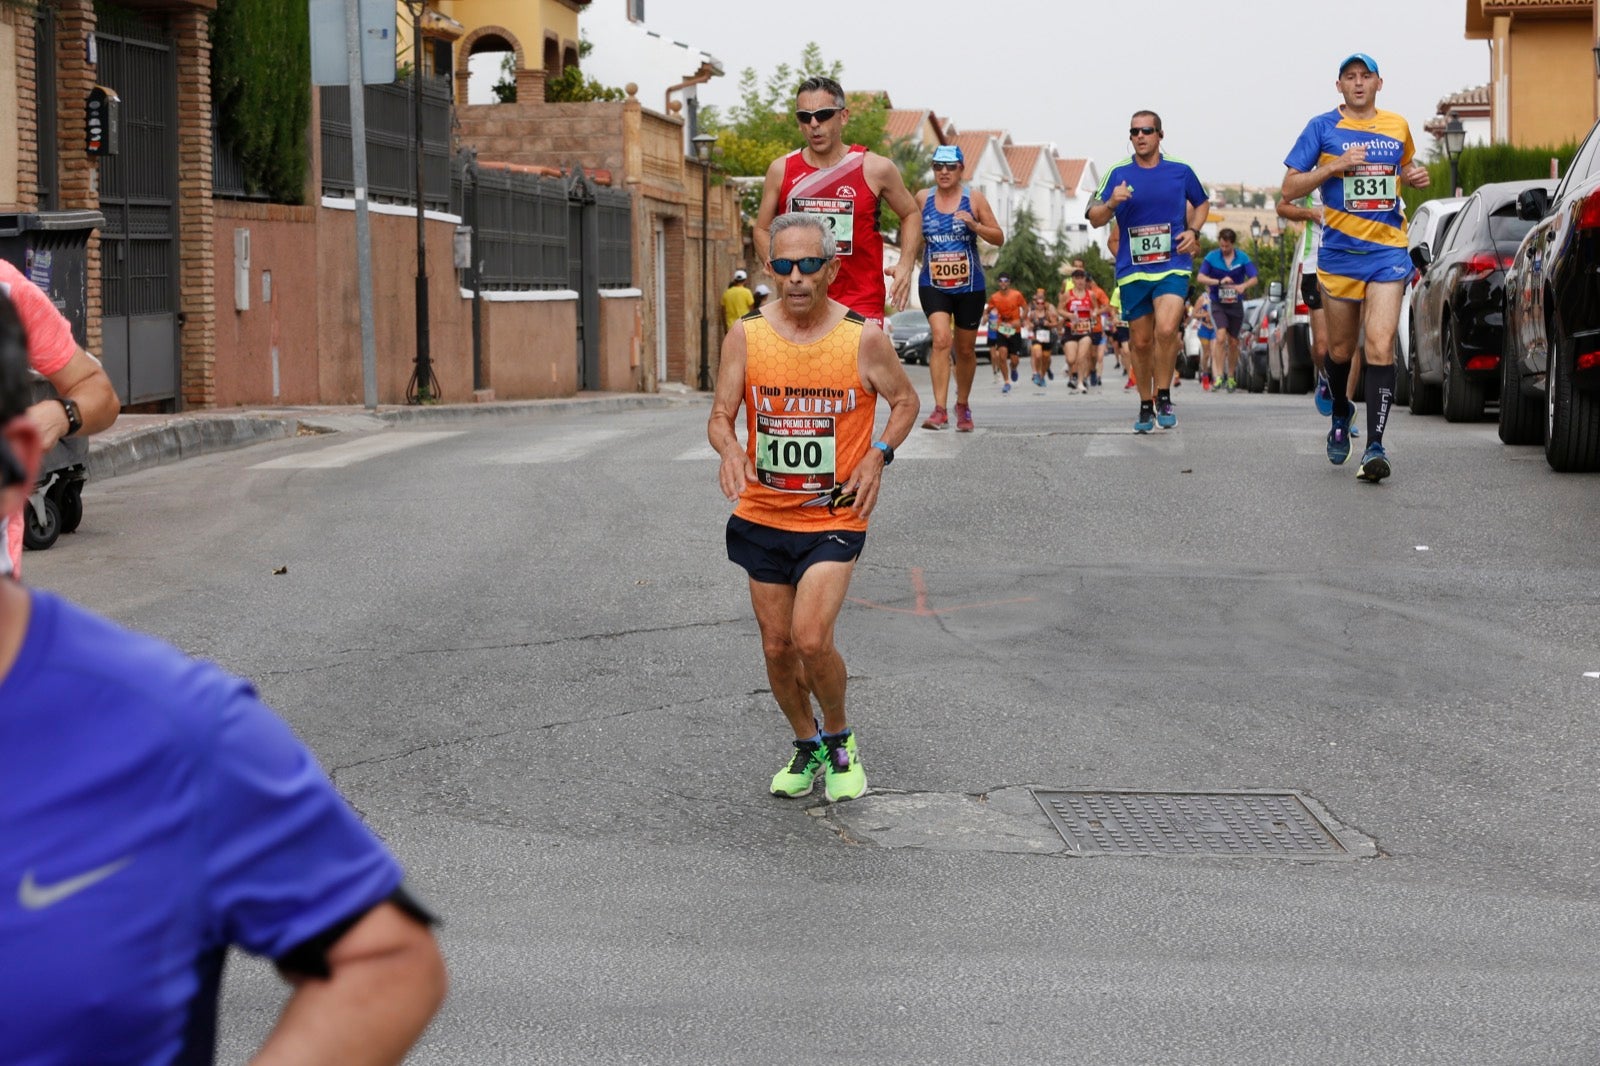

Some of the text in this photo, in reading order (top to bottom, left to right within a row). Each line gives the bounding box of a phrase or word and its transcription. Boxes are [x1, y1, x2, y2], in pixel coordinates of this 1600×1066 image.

[1353, 178, 1387, 196] 831
[1142, 236, 1161, 251] 84
[935, 263, 967, 276] 2068
[751, 385, 857, 414] LA ZUBIA
[759, 385, 844, 398] Club Deportivo
[1375, 387, 1392, 433] kalenji
[769, 418, 782, 428] GRAN
[782, 418, 804, 428] PREMIO
[804, 418, 811, 428] DE
[812, 418, 830, 428] FONDO
[767, 439, 822, 468] 100
